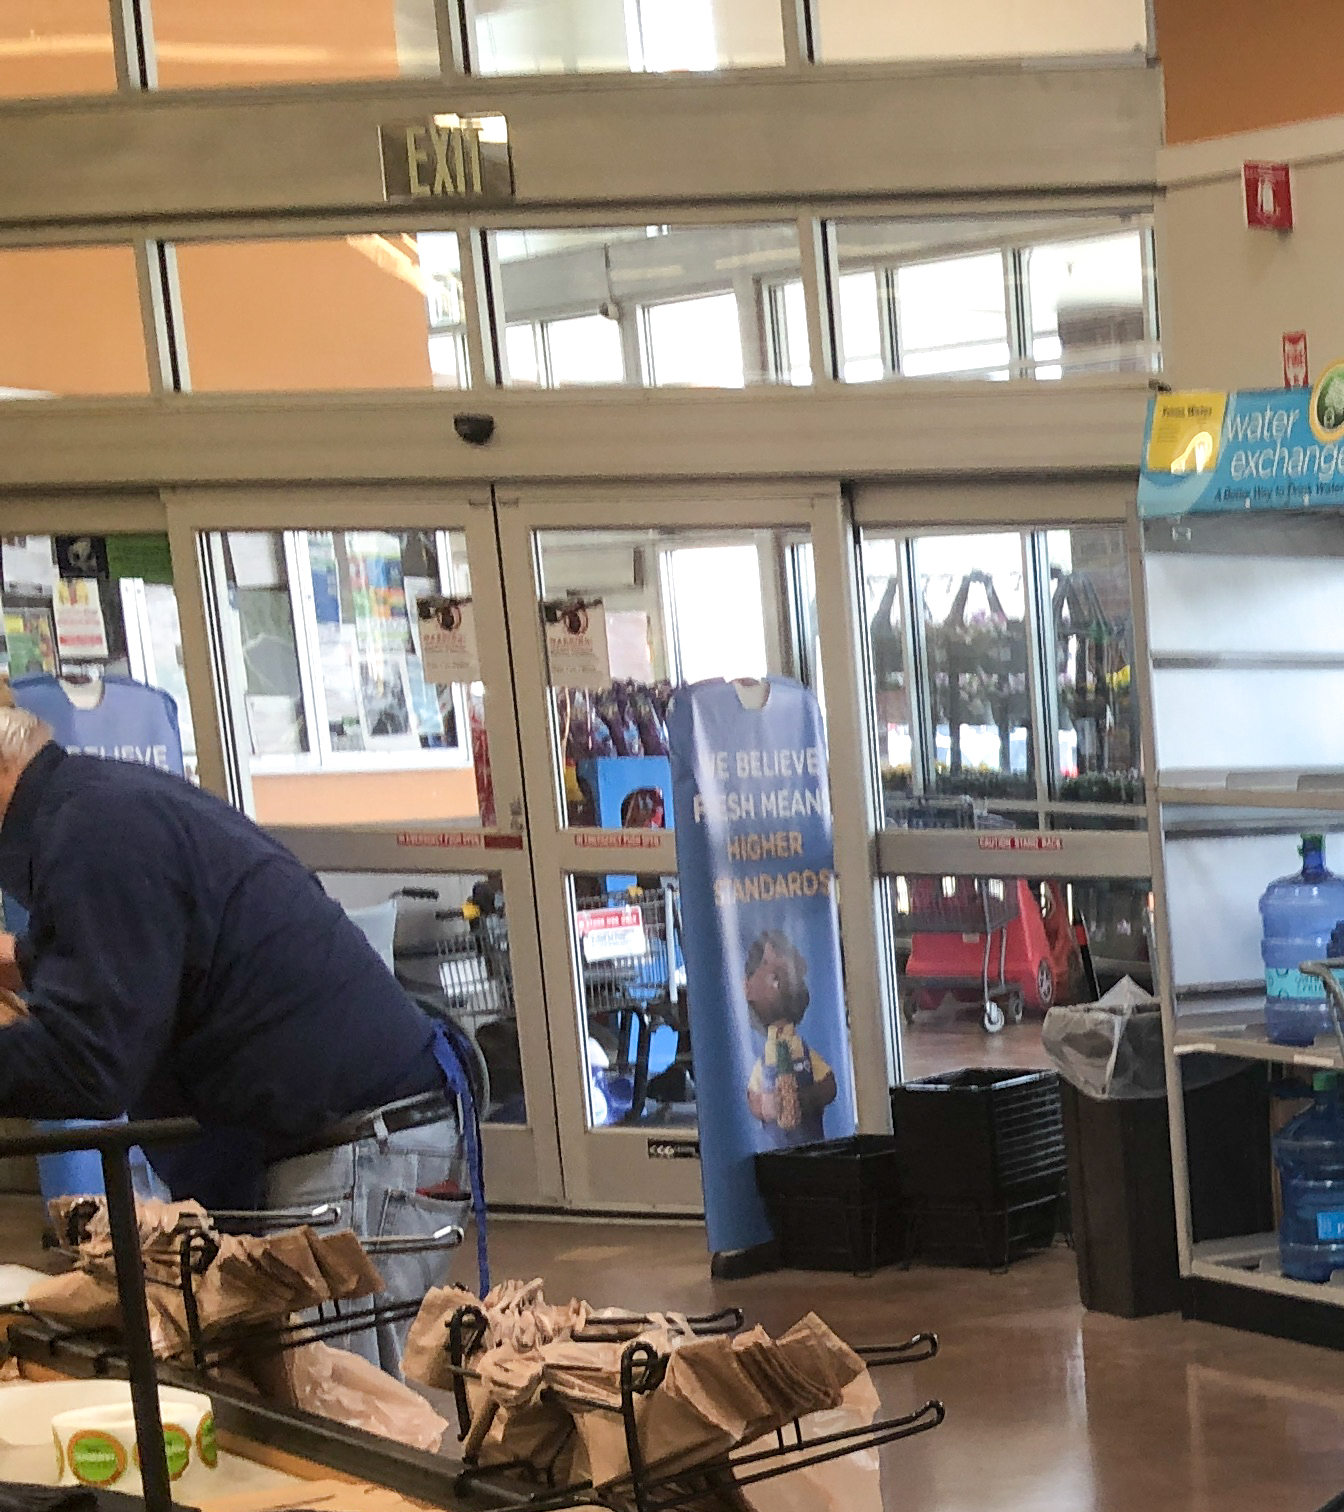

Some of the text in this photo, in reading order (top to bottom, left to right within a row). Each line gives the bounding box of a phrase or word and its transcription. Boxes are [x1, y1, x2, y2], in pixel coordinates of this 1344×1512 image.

[406, 126, 483, 195] EXIT
[1226, 404, 1300, 442] water
[735, 748, 820, 779] BELIEVE
[760, 788, 829, 818] MEAN
[727, 831, 803, 862] HIGHER
[714, 868, 831, 907] SANDARDS
